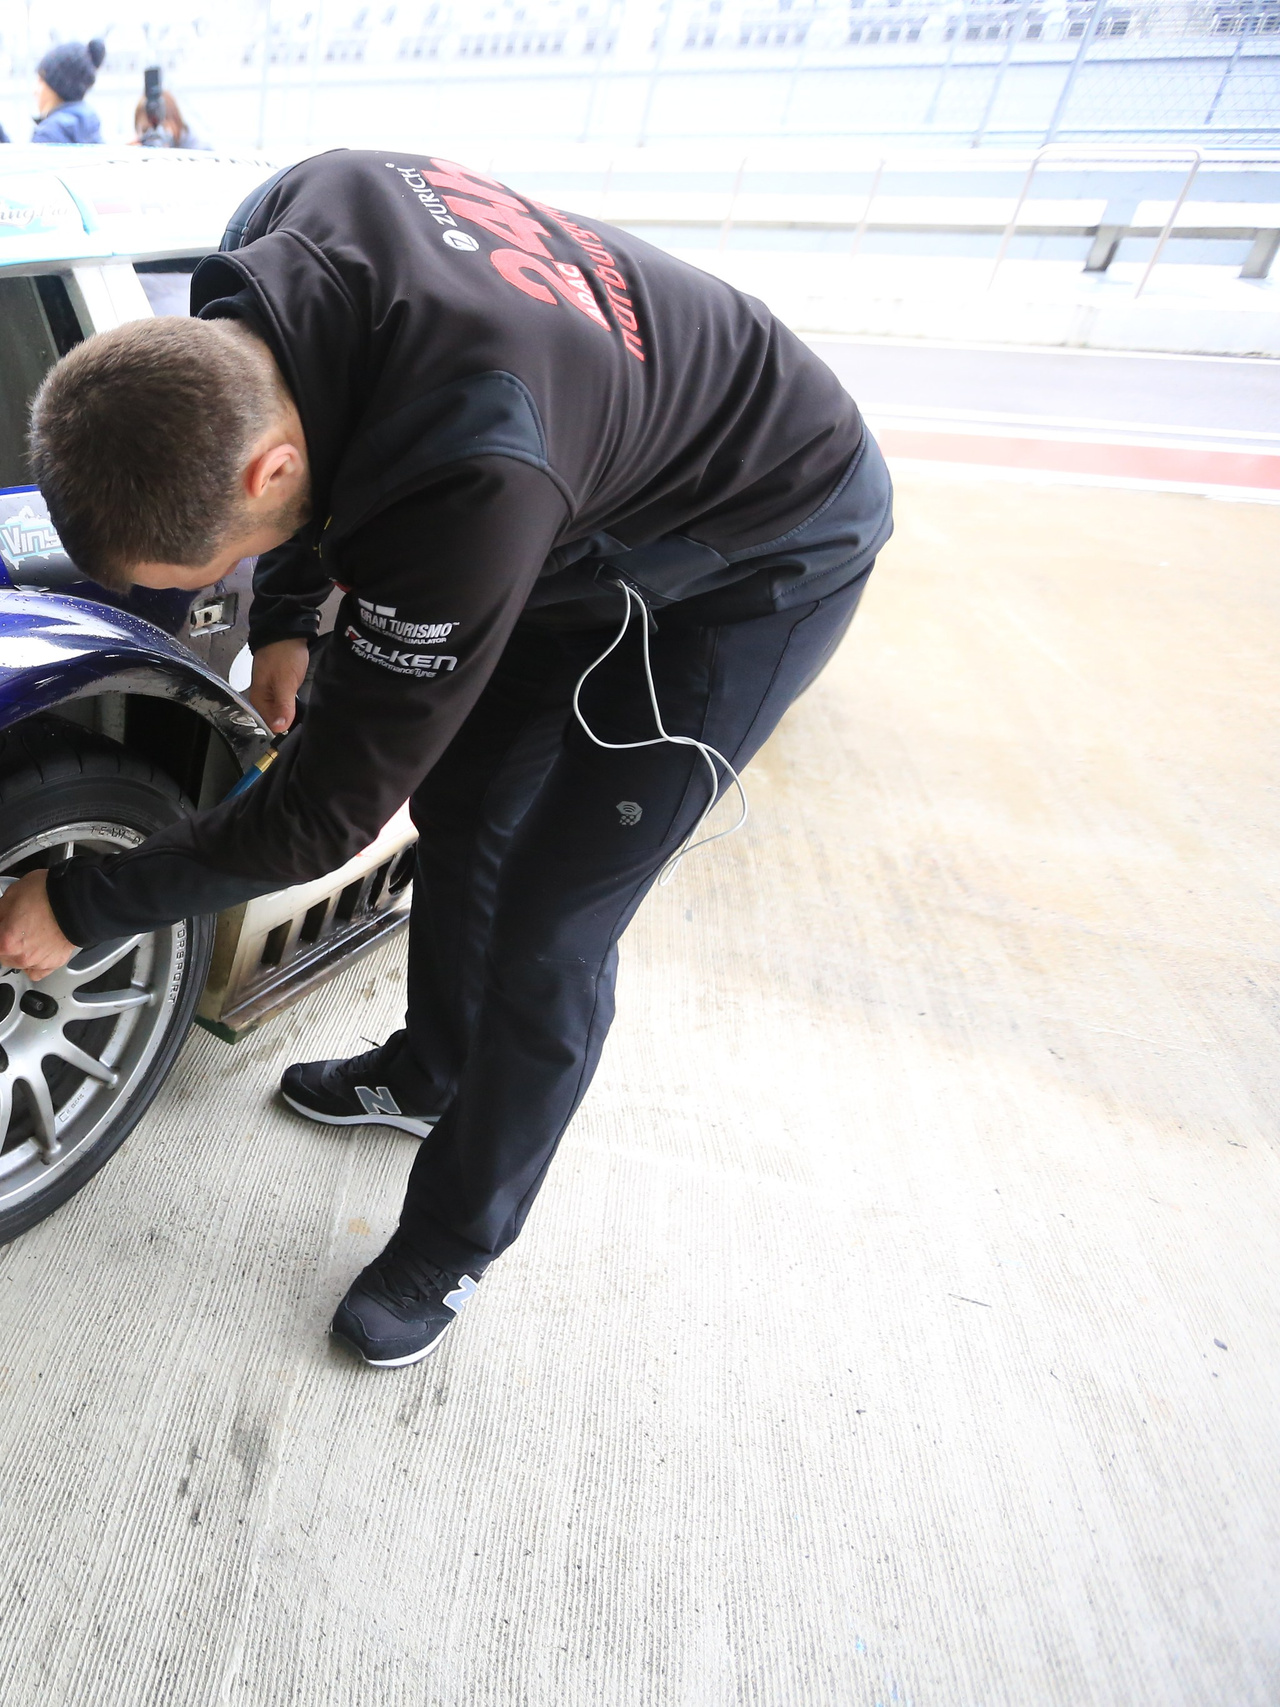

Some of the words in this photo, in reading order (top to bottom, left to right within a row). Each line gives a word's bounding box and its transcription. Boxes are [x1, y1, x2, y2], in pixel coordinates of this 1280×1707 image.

[397, 167, 458, 227] ZURICH
[558, 263, 607, 328] ADAC
[360, 607, 387, 630] GRAN
